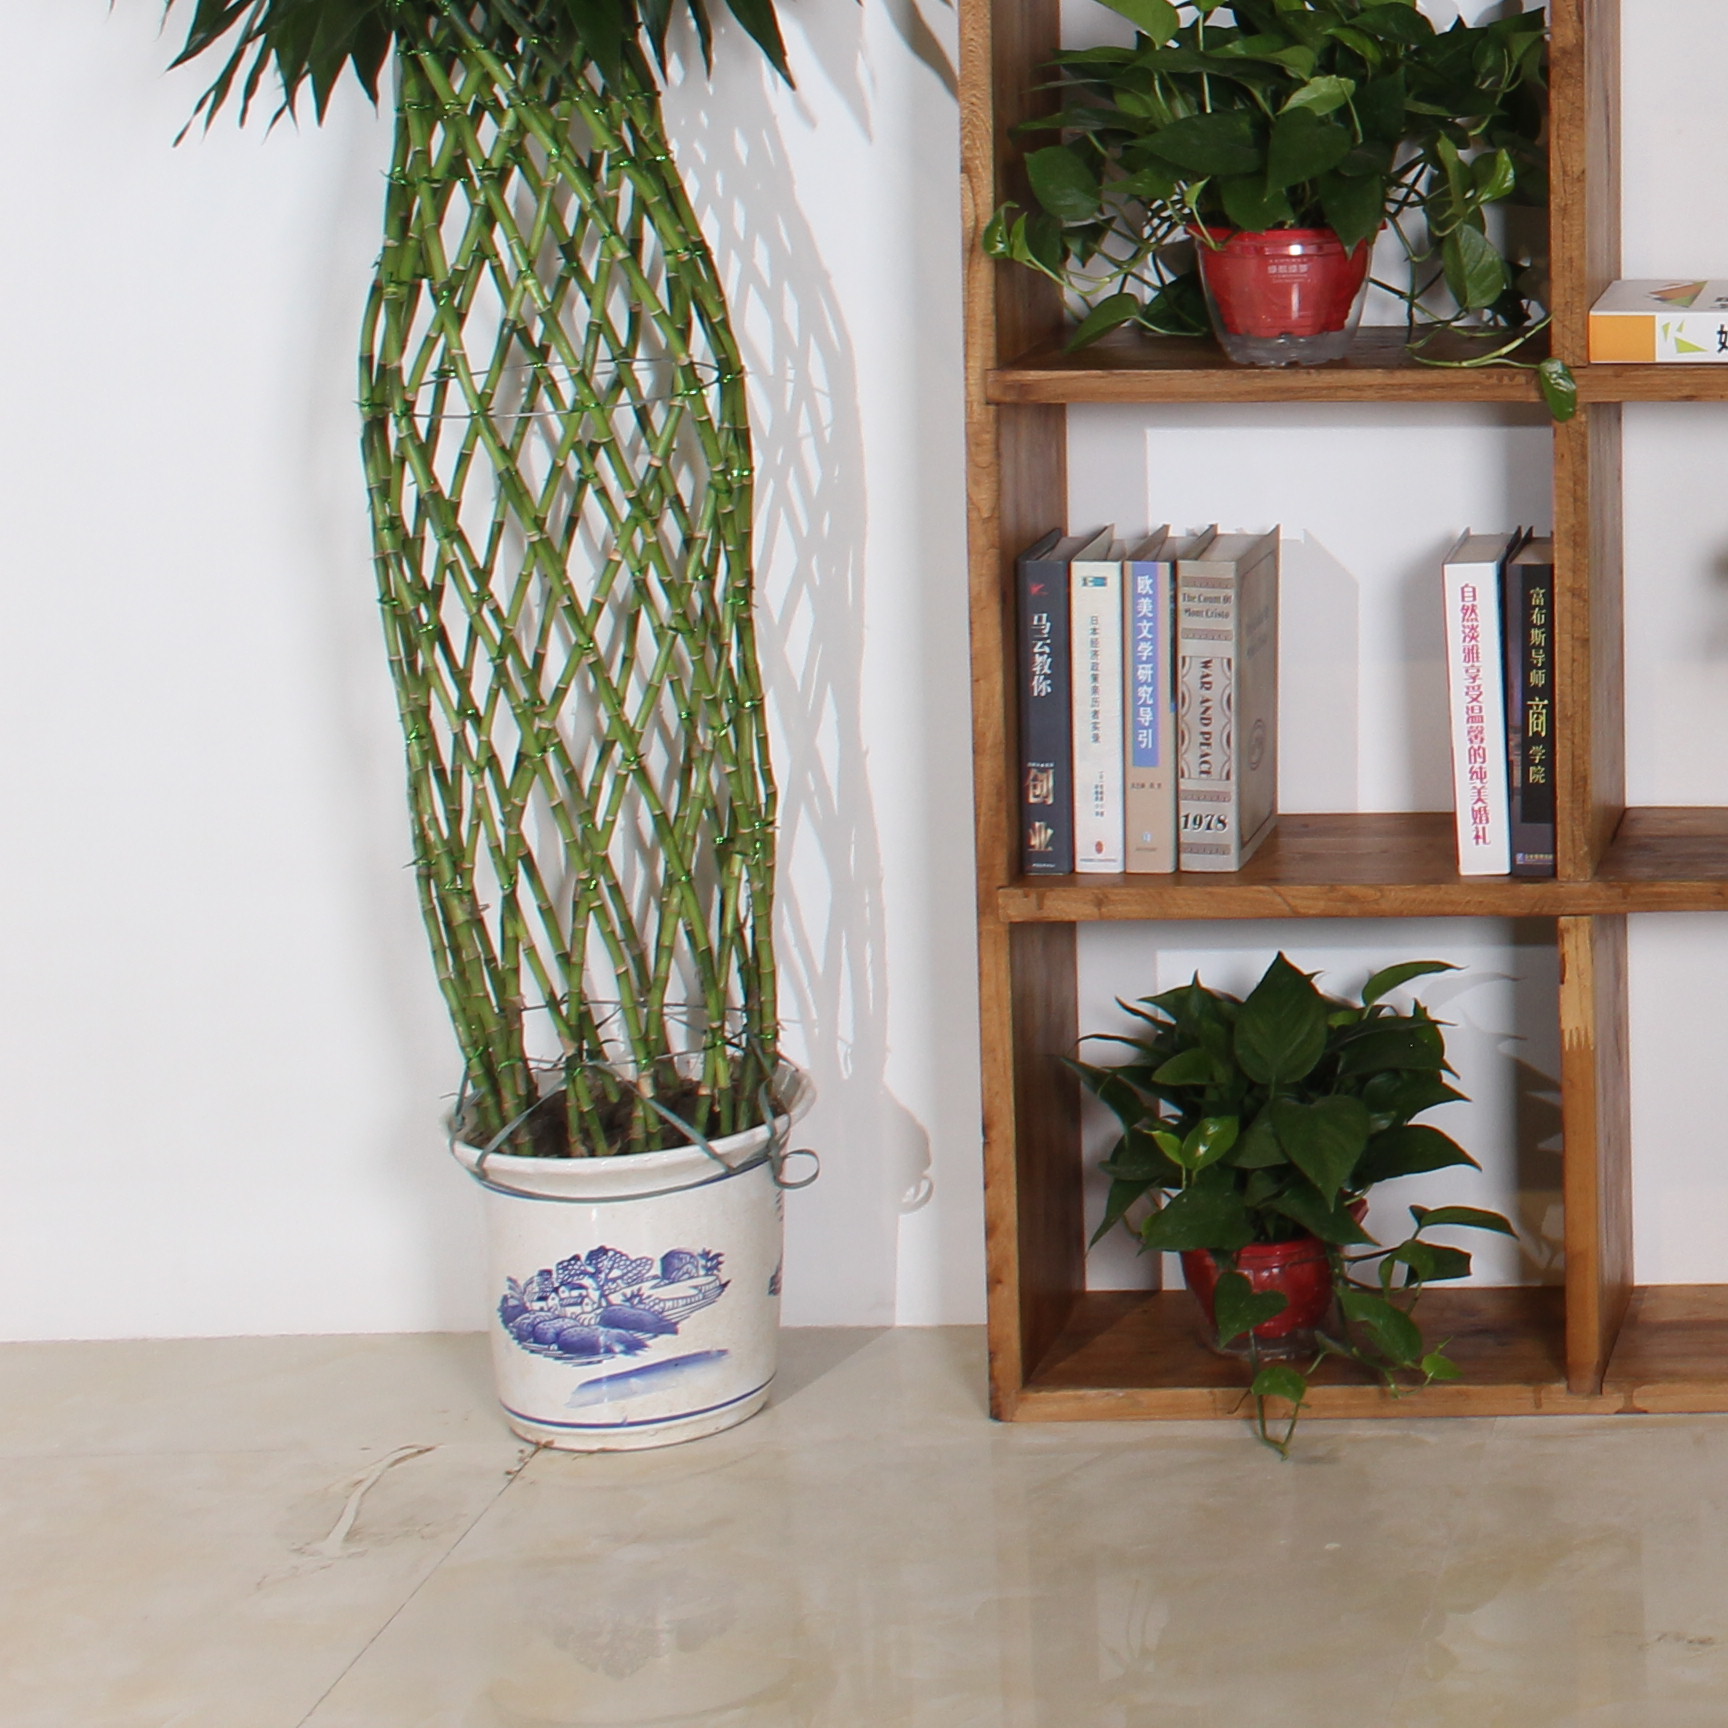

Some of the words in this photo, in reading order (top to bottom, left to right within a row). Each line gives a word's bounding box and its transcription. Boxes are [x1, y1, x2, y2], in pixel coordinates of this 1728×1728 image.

[1030, 611, 1053, 698] 马云教你
[1135, 575, 1154, 750] 欧美文学研究导引
[1199, 658, 1213, 691] WAR
[1529, 586, 1547, 688] 富布斯导师
[1199, 696, 1213, 728] AND
[1199, 731, 1213, 777] PEACE
[1459, 583, 1492, 847] 自然淡雅享受温馨的纯美婚礼
[1526, 696, 1549, 784] 商学院
[1180, 812, 1229, 834] 1978
